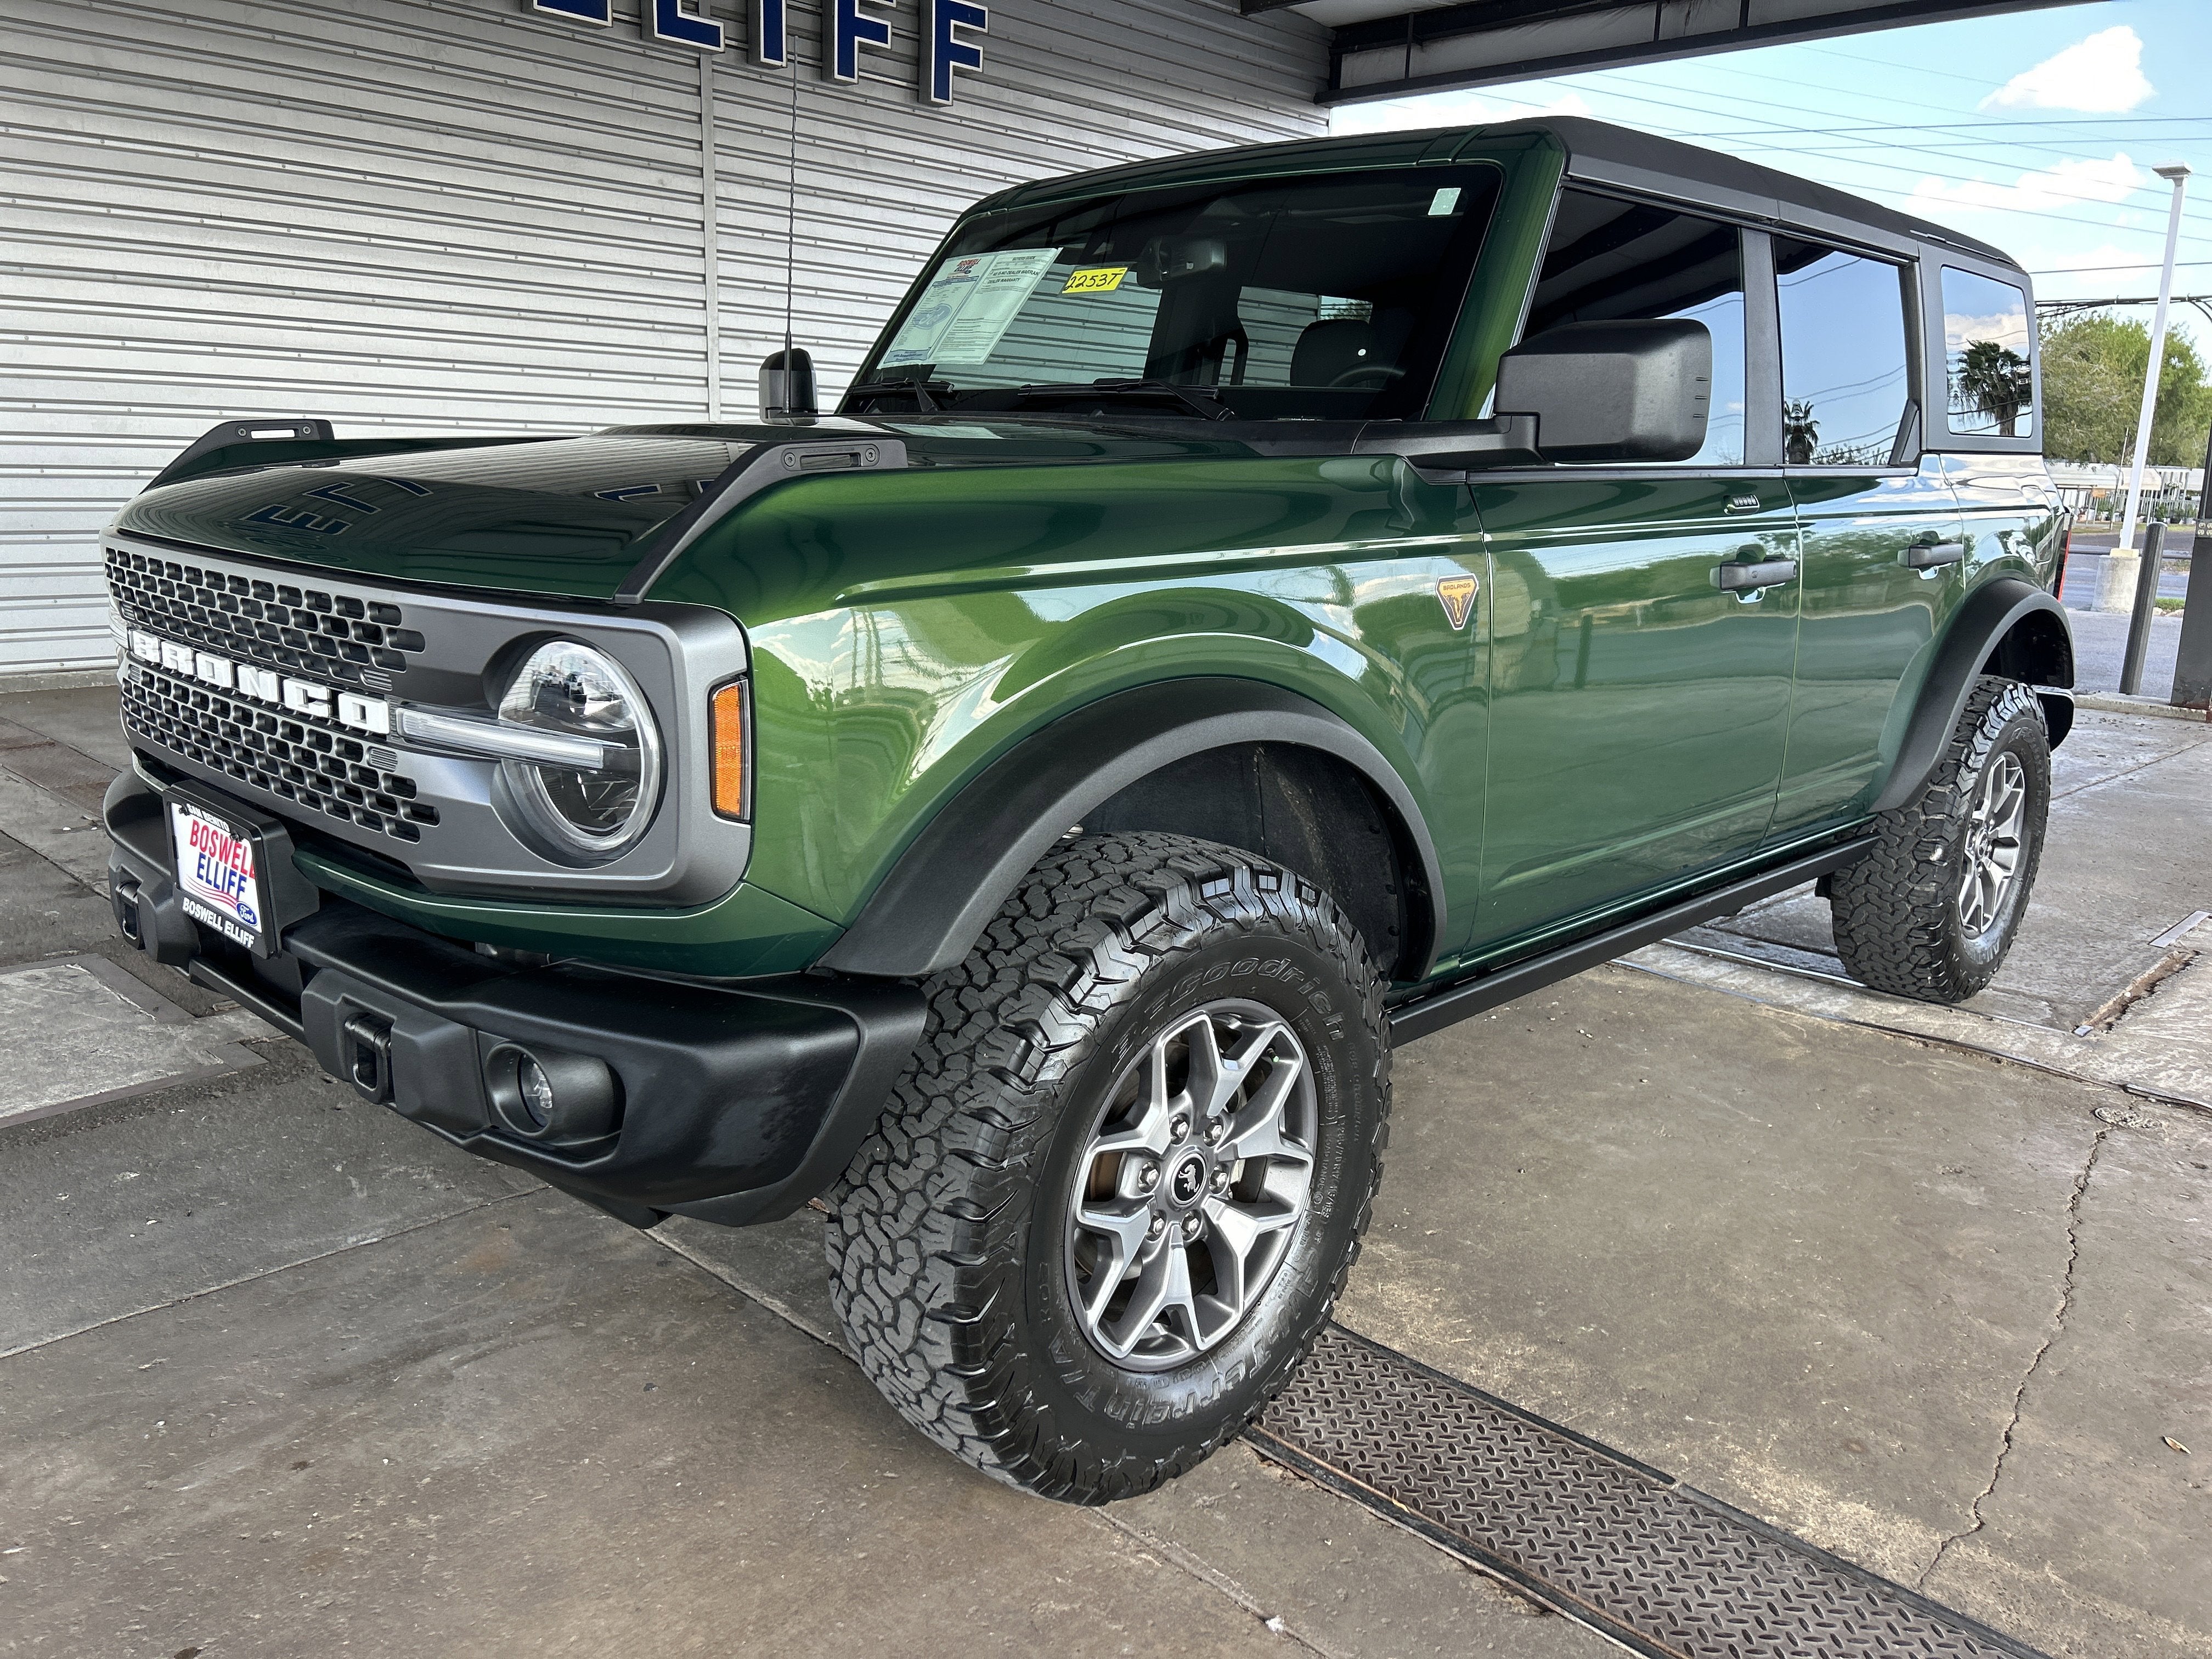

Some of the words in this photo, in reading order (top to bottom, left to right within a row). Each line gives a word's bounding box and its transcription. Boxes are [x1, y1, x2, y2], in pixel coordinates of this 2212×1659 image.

[533, 0, 988, 105] LIFF
[1443, 583, 1471, 591] BADLANDS
[130, 628, 390, 735] BRONCO
[187, 803, 204, 819] SAN
[197, 851, 247, 900] ELLIFF
[182, 897, 224, 932] BOSWELL
[224, 921, 255, 948] ELLIFF
[240, 904, 255, 922] Ford
